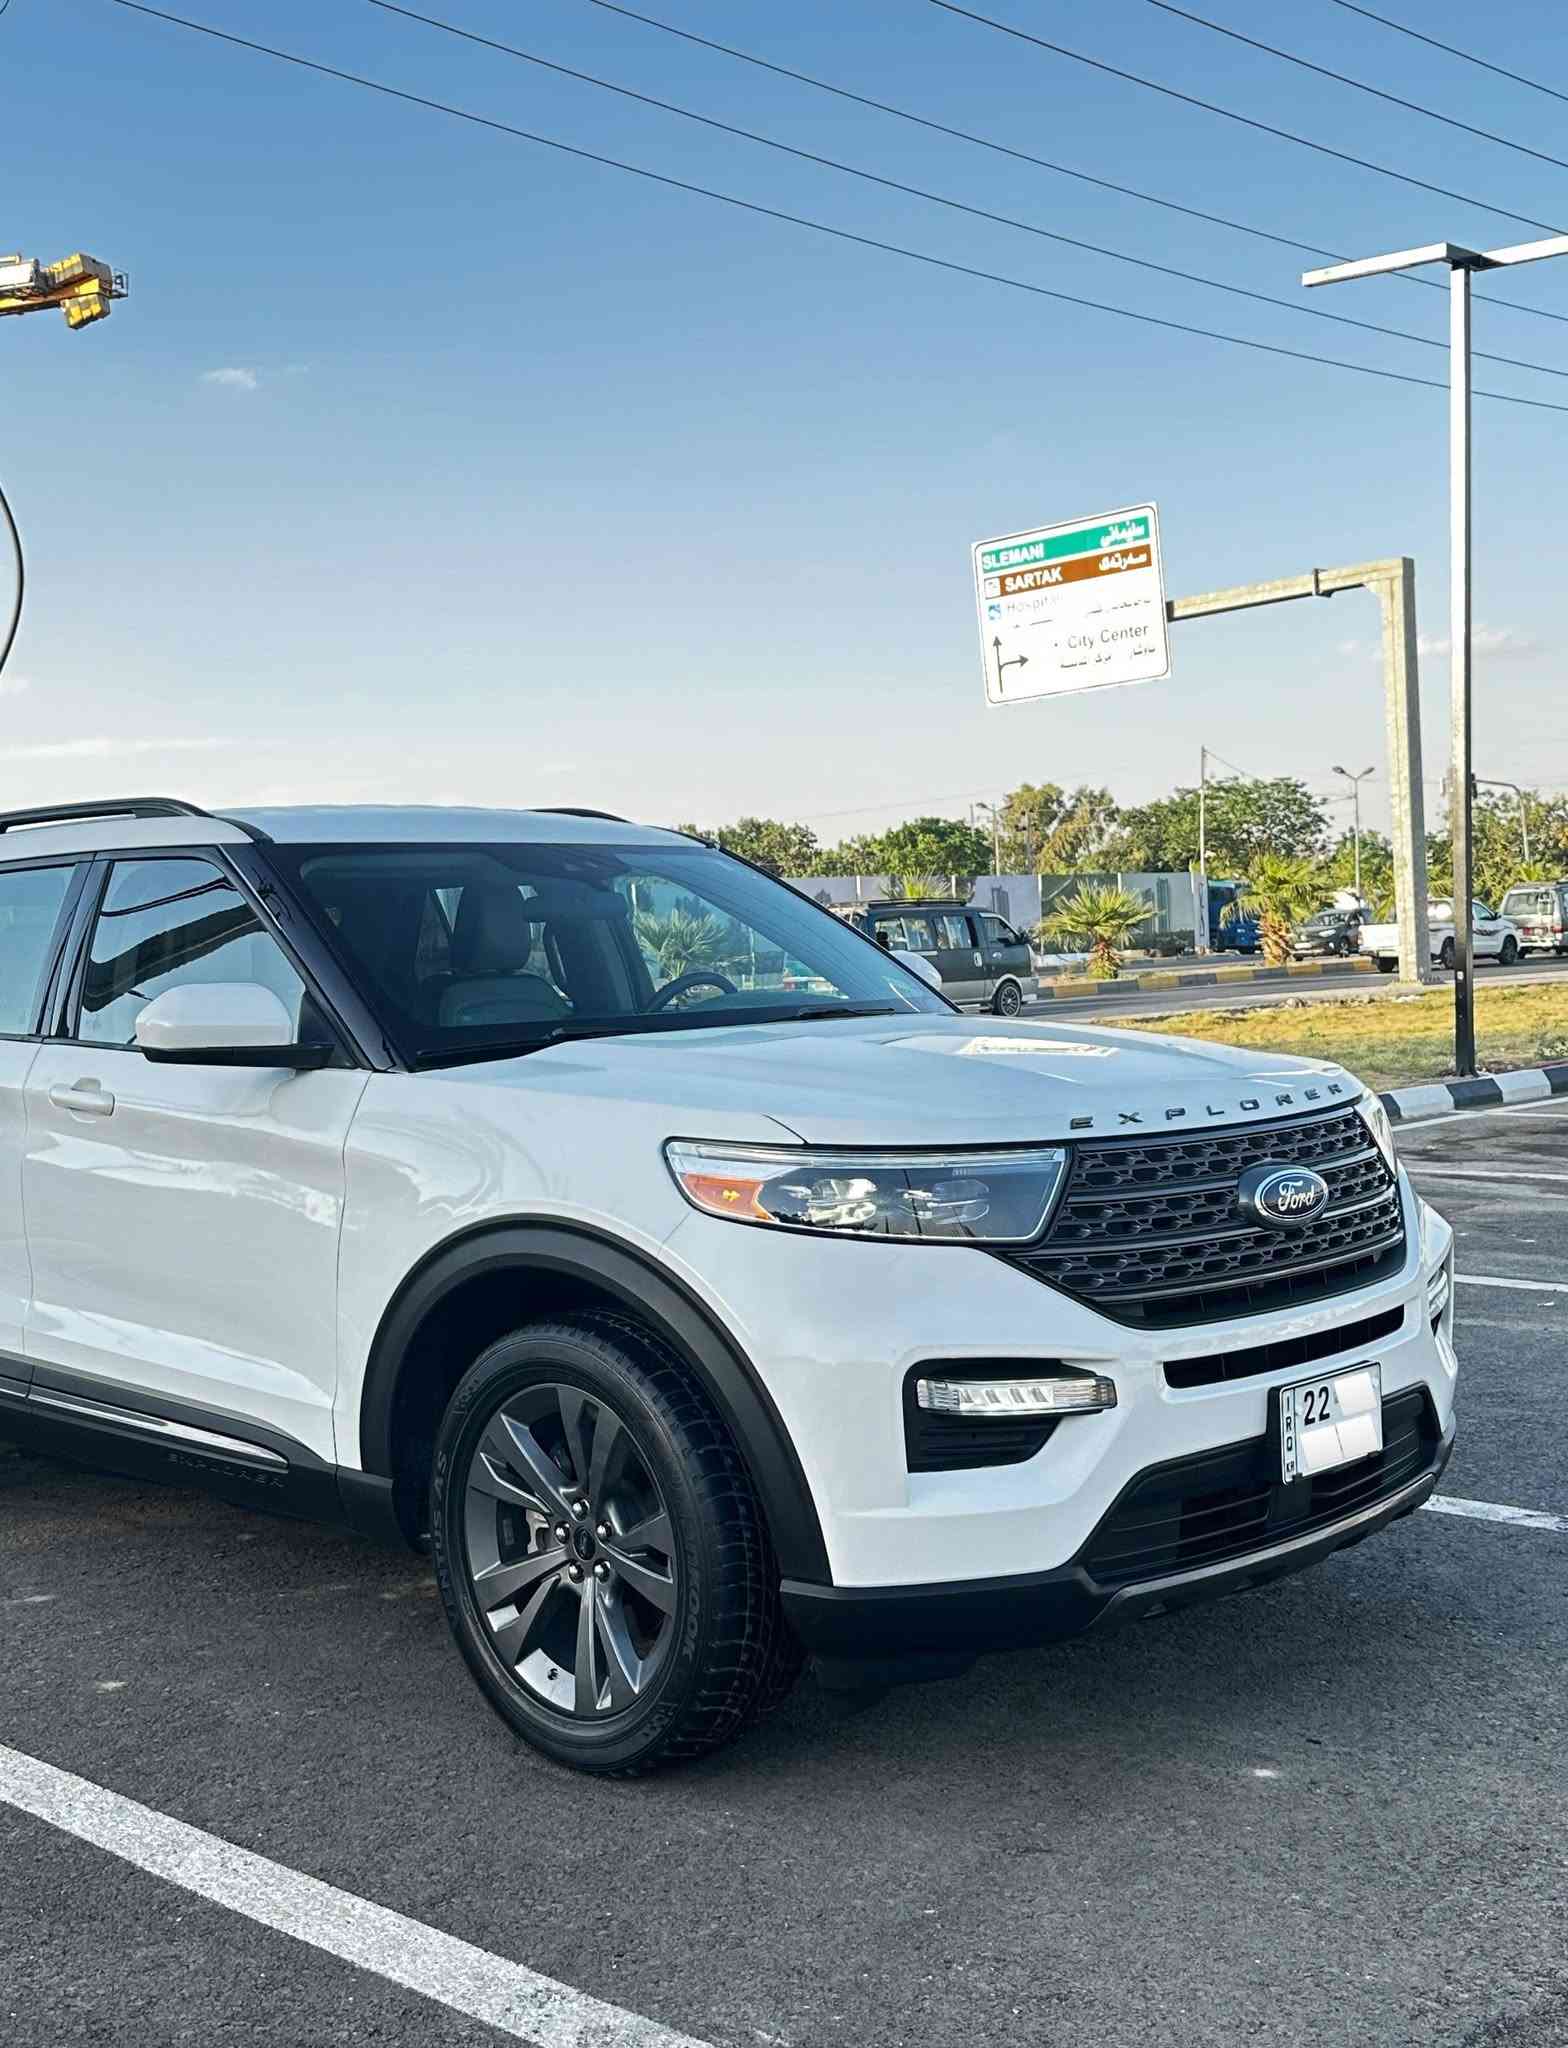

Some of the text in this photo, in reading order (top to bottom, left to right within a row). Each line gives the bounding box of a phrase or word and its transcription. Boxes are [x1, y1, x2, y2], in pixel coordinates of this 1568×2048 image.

[982, 544, 1044, 570] SLEMANI
[1004, 566, 1063, 593] SARTAK
[1067, 625, 1149, 650] City Center
[1069, 1082, 1345, 1130] EXPLORER
[1278, 1181, 1315, 1212] Ford
[1304, 1385, 1331, 1426] 22
